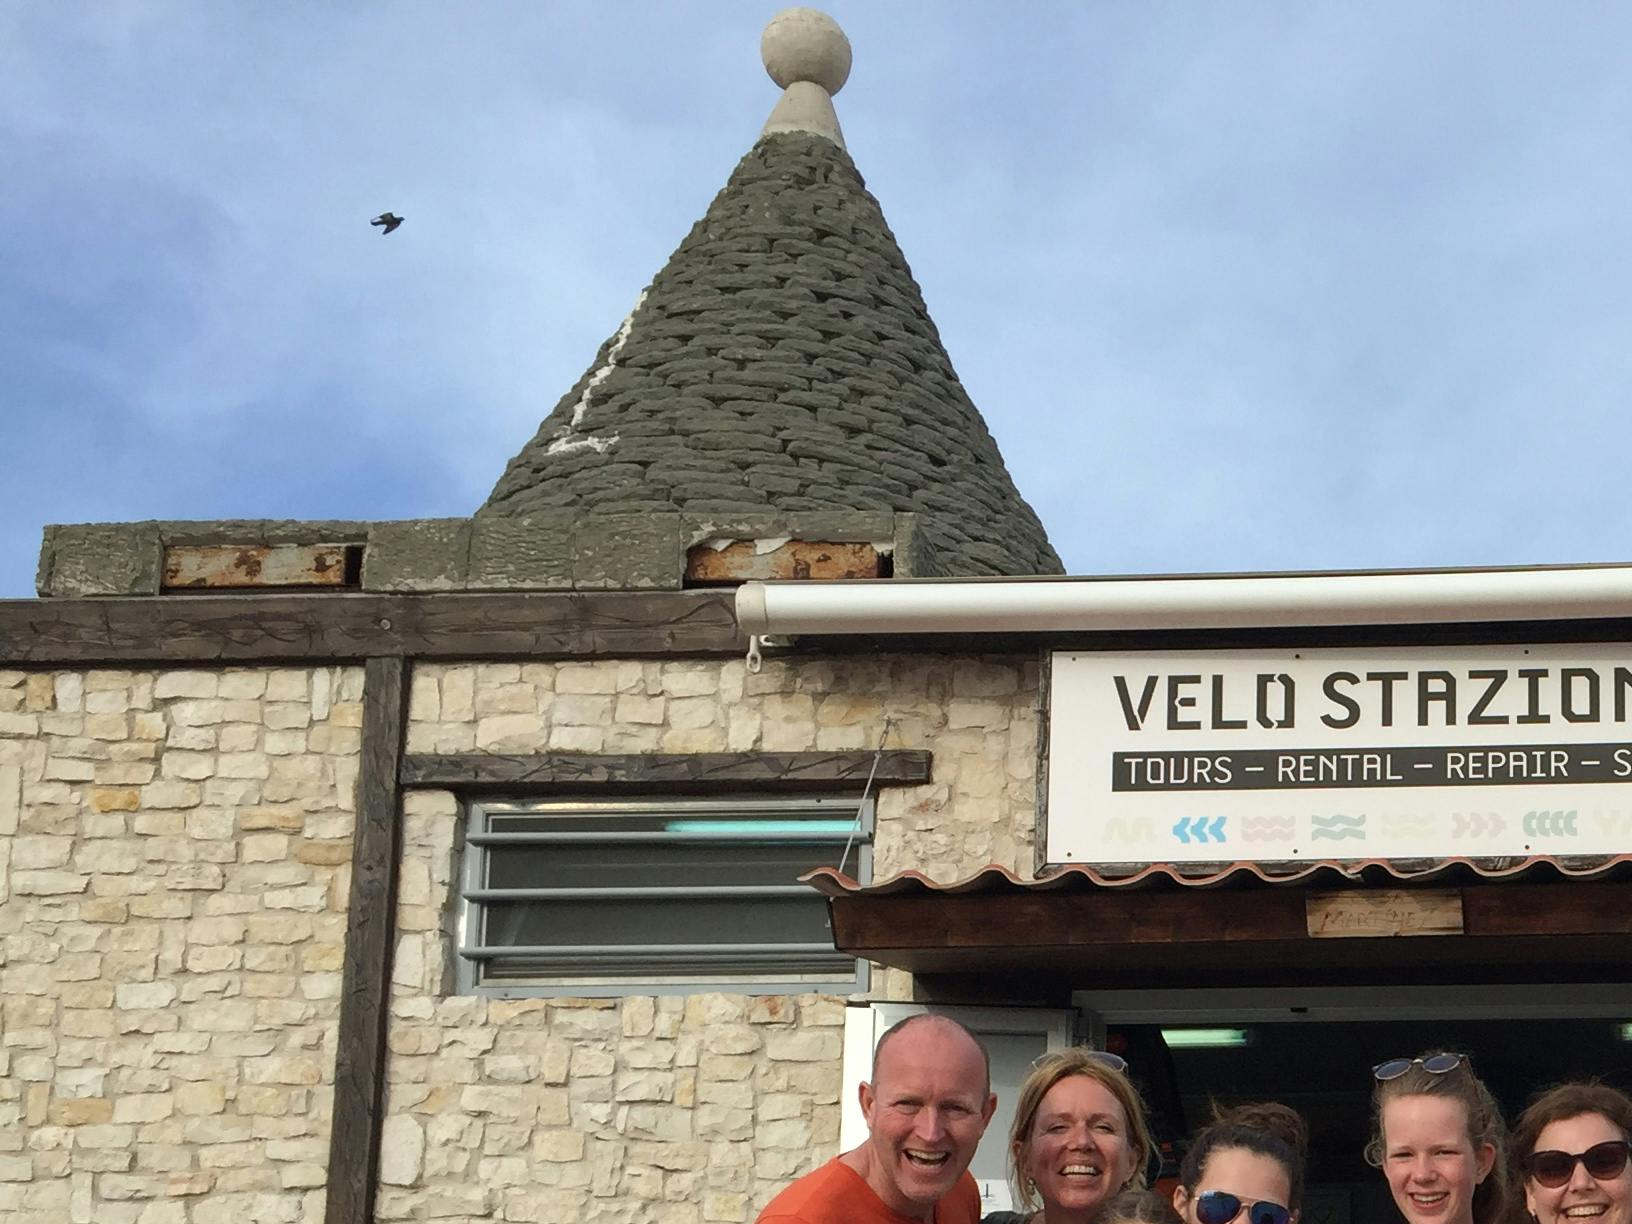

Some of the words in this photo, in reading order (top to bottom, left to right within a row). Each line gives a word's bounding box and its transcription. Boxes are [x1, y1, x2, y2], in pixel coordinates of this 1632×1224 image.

[1113, 673, 1296, 732] VELO
[1123, 756, 1233, 785] TOURS
[1277, 753, 1403, 783] RENTAL
[1446, 750, 1569, 779] REPAIR
